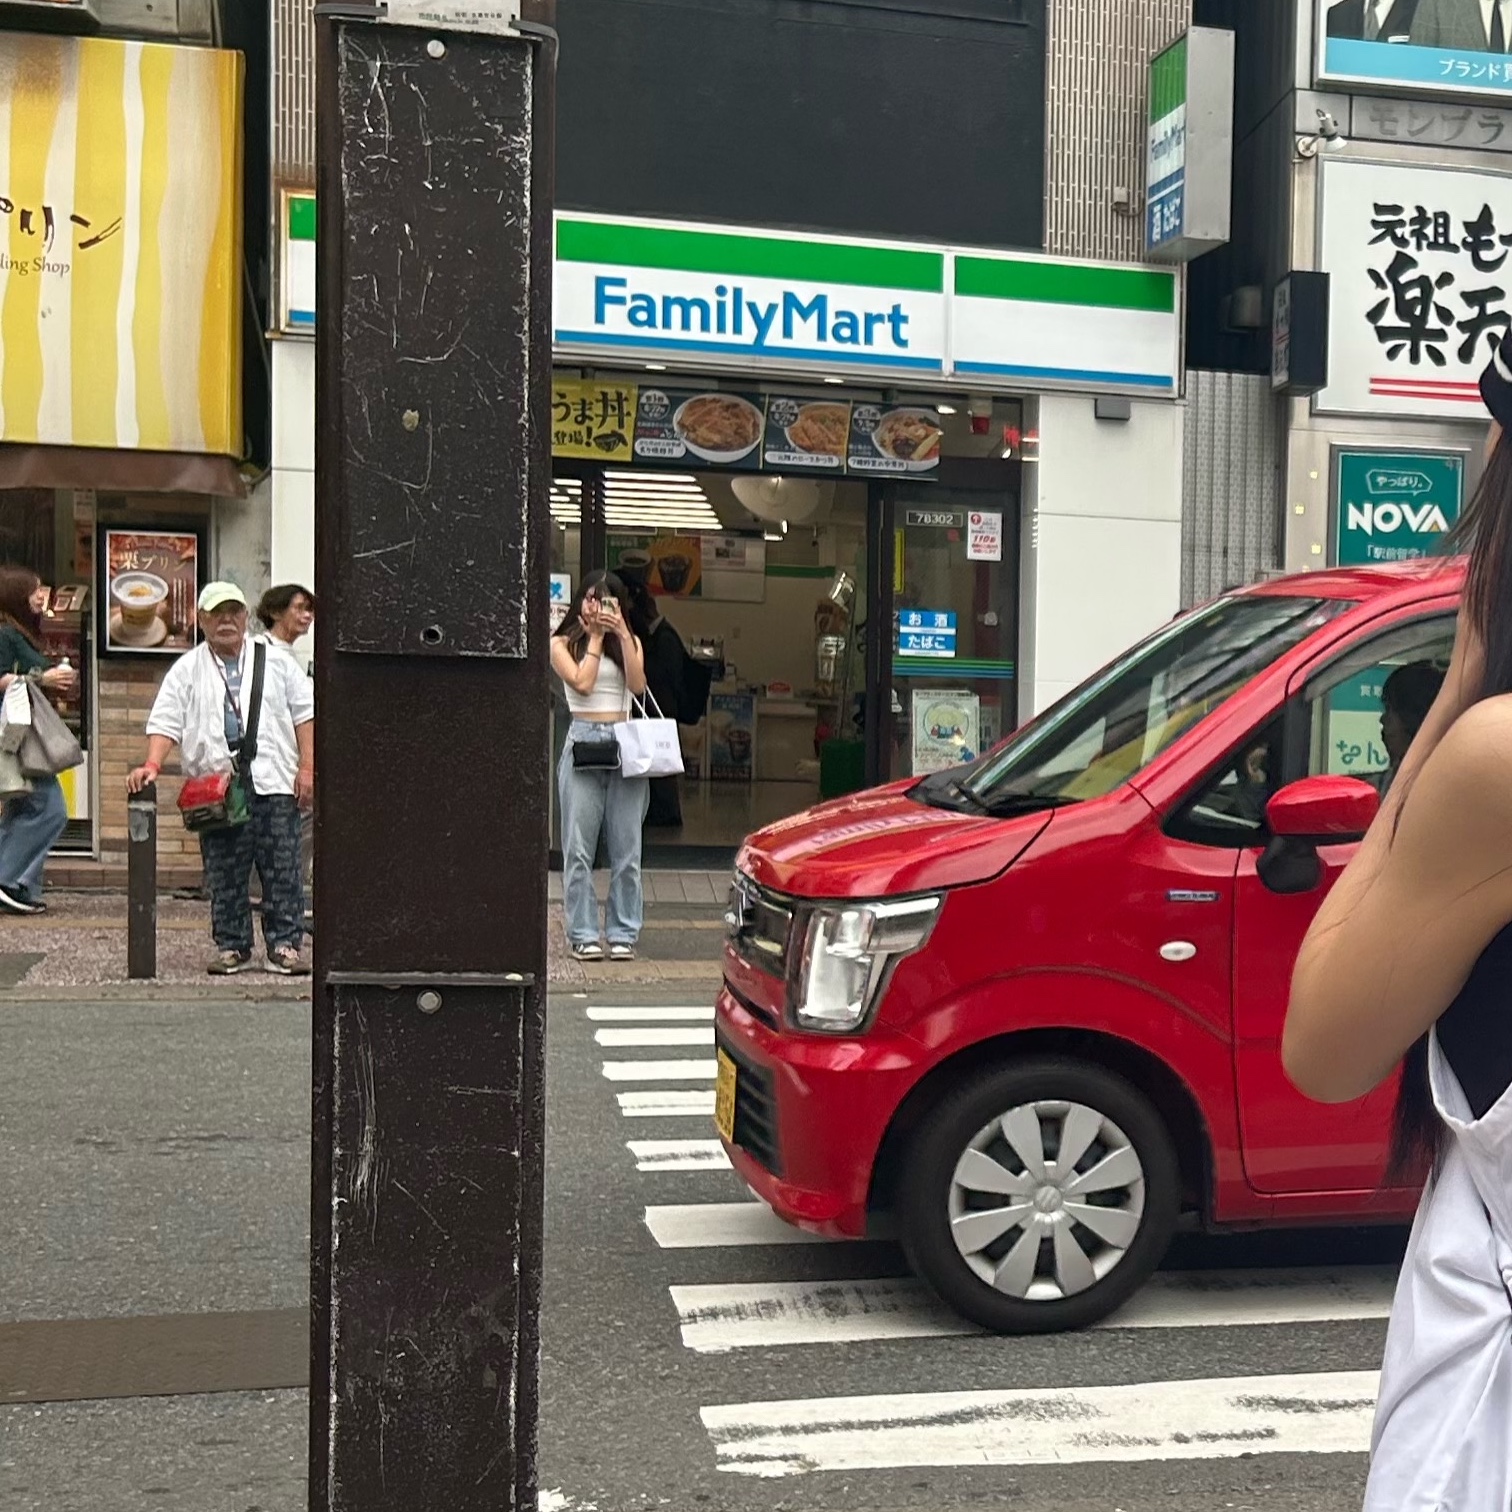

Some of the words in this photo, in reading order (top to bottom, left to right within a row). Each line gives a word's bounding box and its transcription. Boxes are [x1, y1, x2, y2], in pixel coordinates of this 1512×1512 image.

[32, 256, 71, 278] Shop
[592, 274, 910, 349] FamilyMart
[1365, 250, 1512, 367] 楽天
[552, 390, 632, 430] うま丼
[1347, 502, 1451, 537] NOVA
[119, 550, 187, 572] 栗プリン
[908, 634, 947, 650] たばこ
